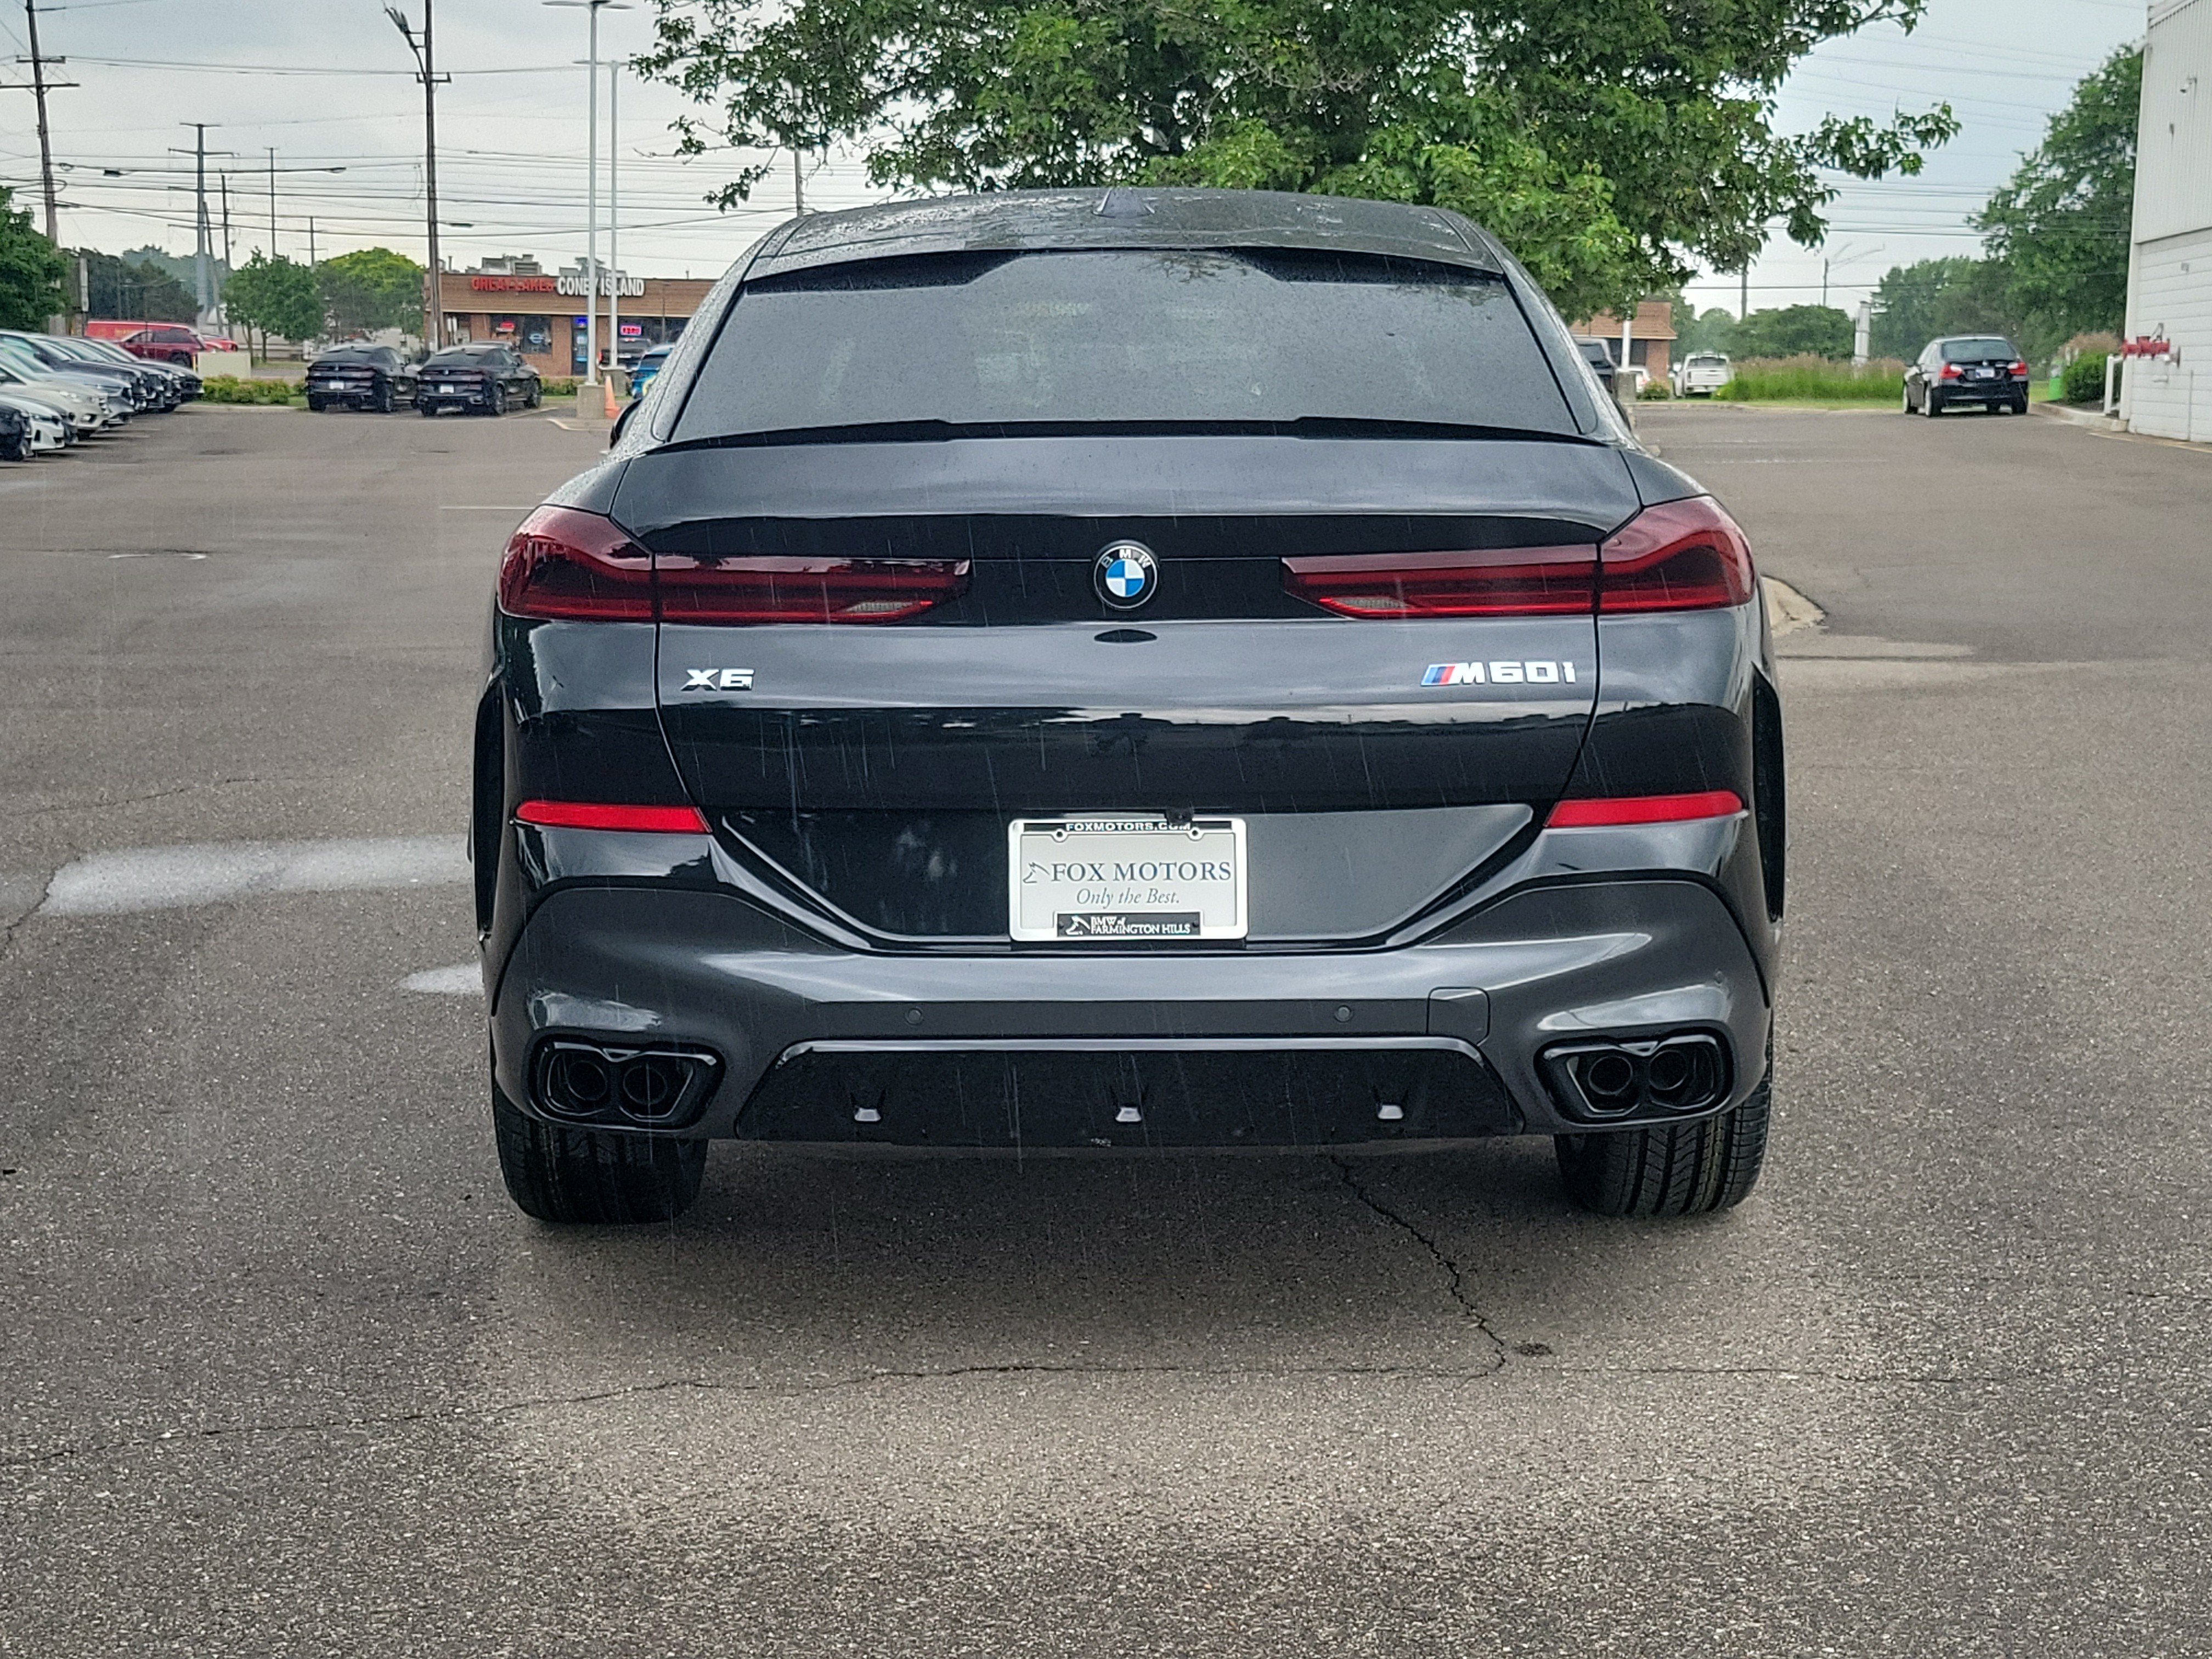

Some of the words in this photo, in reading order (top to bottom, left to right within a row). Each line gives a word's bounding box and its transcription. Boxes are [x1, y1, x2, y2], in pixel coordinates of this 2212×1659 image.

[1101, 549, 1152, 568] BMW
[680, 668, 755, 691] X6
[1065, 822, 1191, 832] FOXMOTORS.COM
[1051, 862, 1105, 881] FOX
[1113, 861, 1232, 881] MOTORS
[1076, 887, 1114, 909] Only
[1119, 887, 1141, 904] the
[1147, 888, 1180, 904] Best.
[1091, 916, 1117, 926] BMW
[1091, 923, 1160, 934] FARMINGTON
[1161, 923, 1191, 934] HILLS
